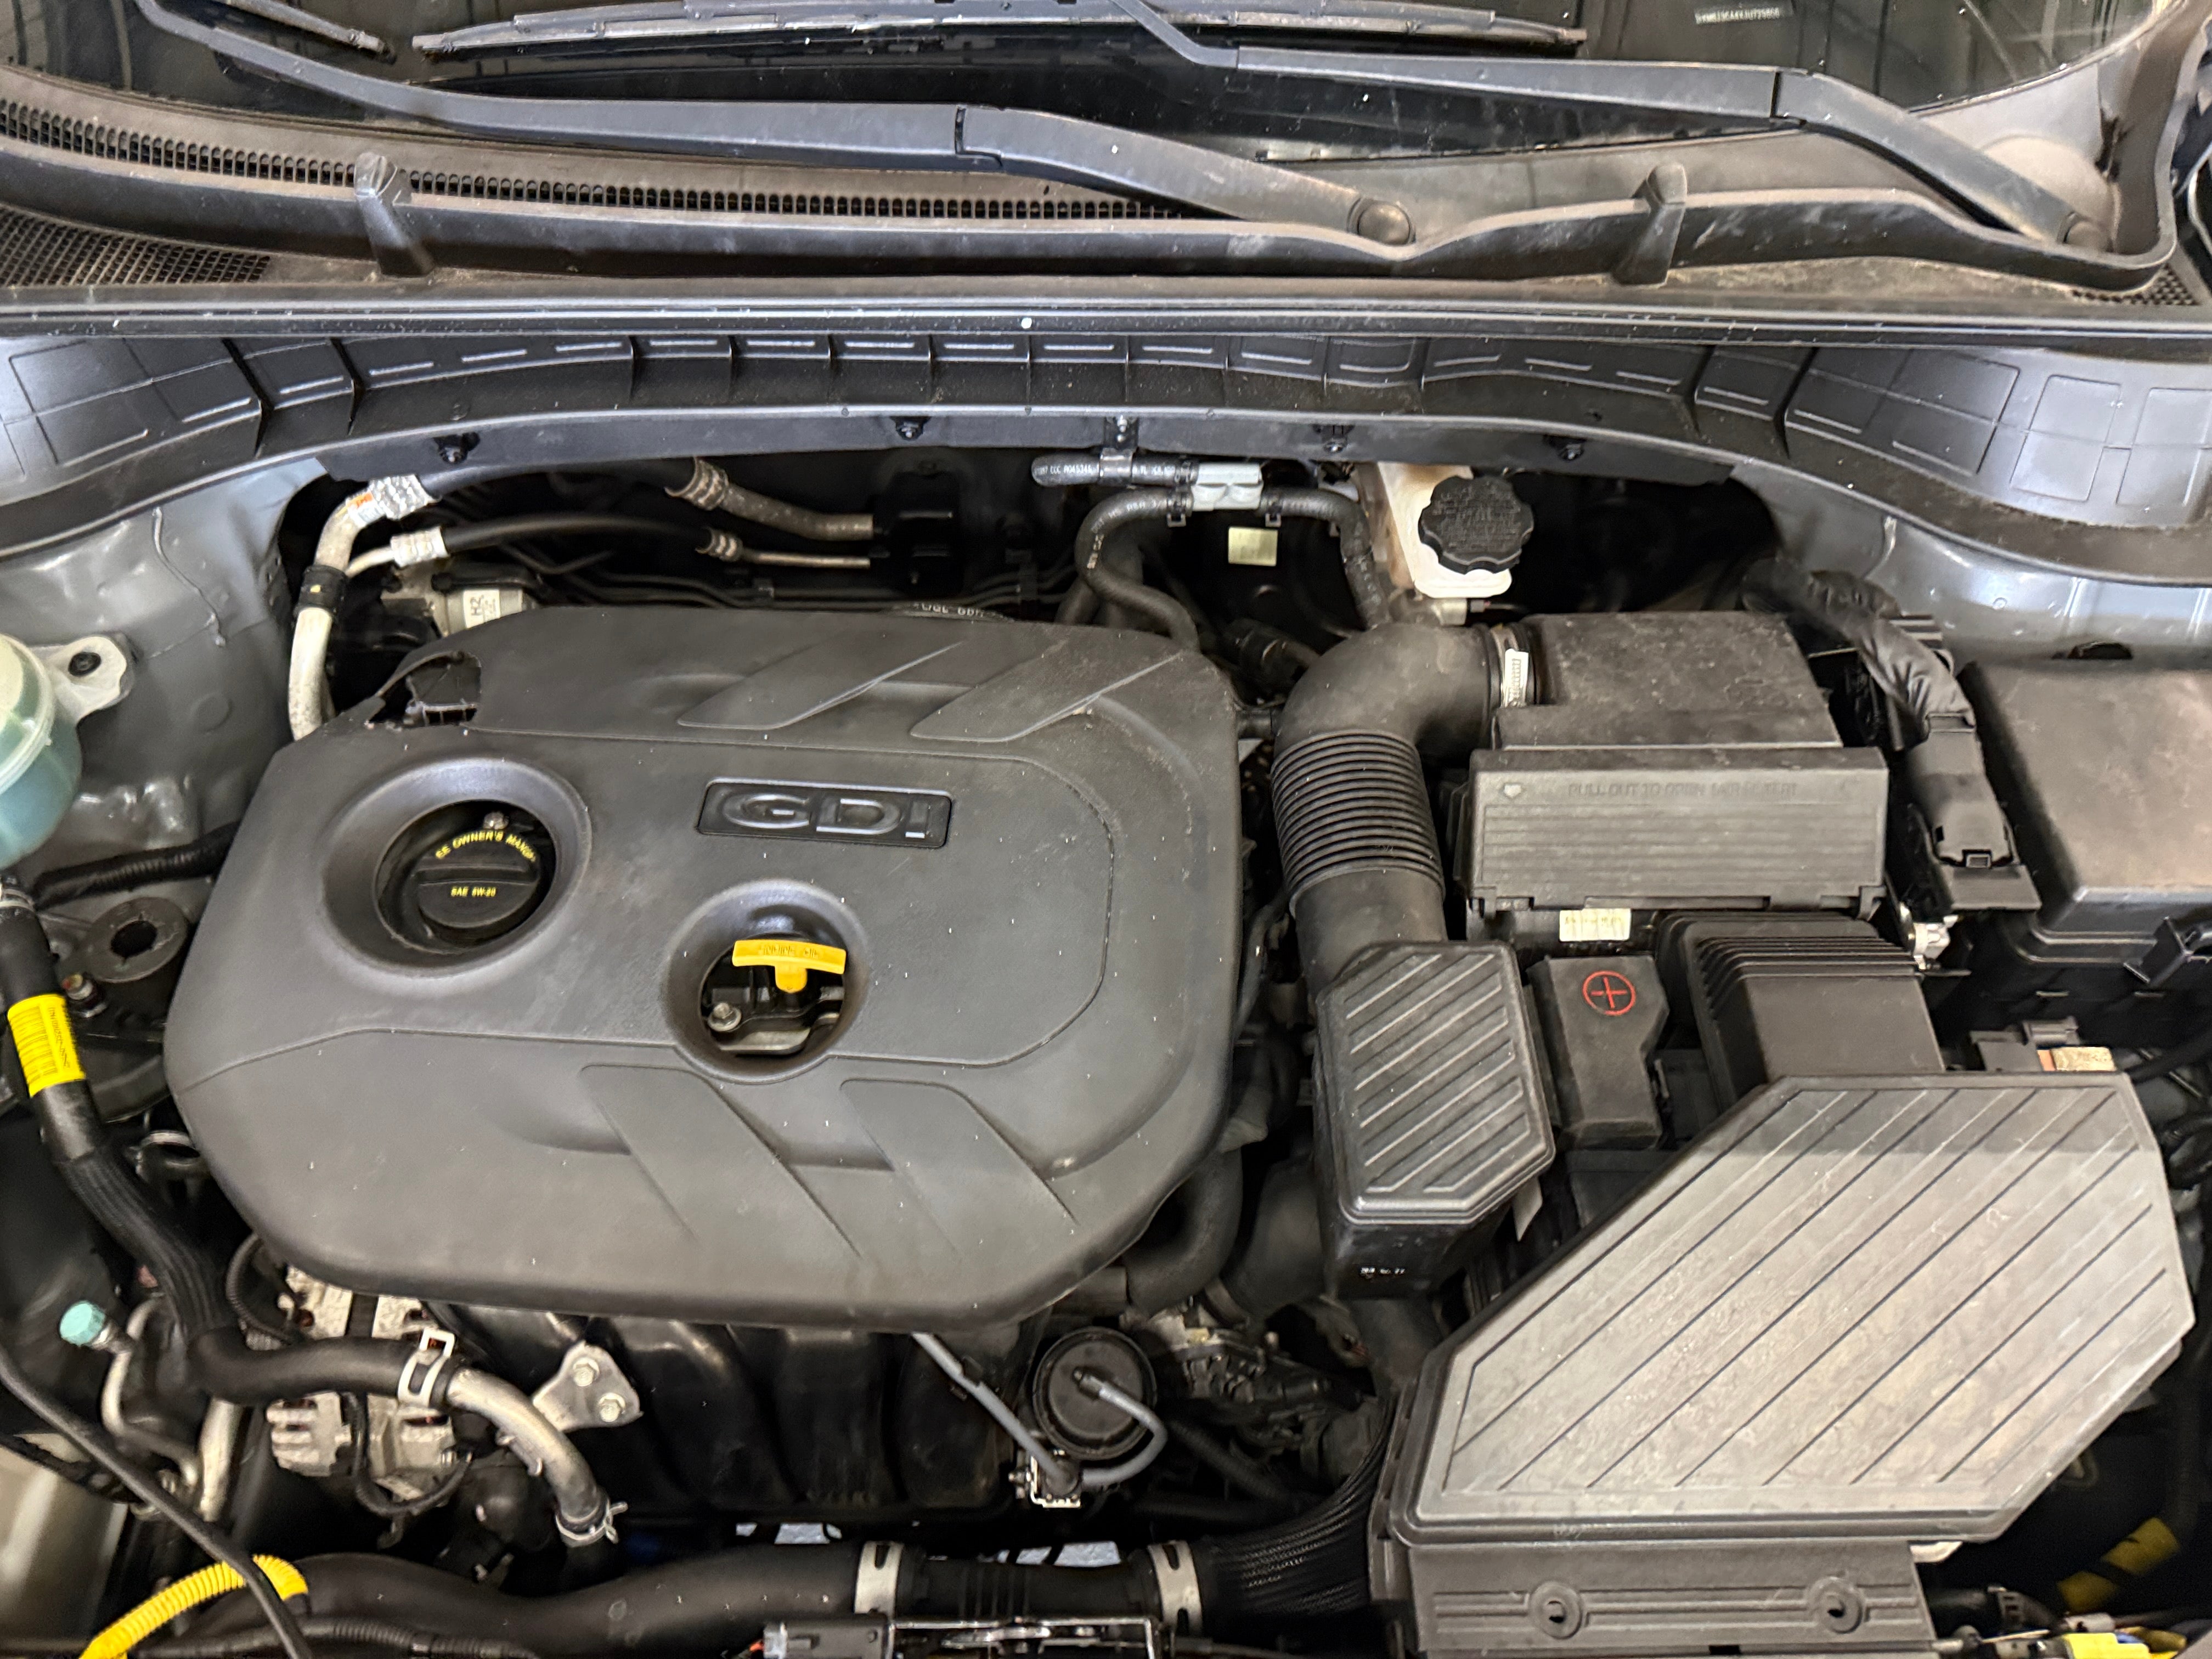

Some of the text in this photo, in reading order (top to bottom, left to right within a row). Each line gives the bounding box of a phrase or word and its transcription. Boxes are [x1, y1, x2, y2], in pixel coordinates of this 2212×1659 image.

[1609, 783, 1638, 797] OUT
[452, 830, 504, 849] OWNER'S
[450, 886, 469, 897] SAE
